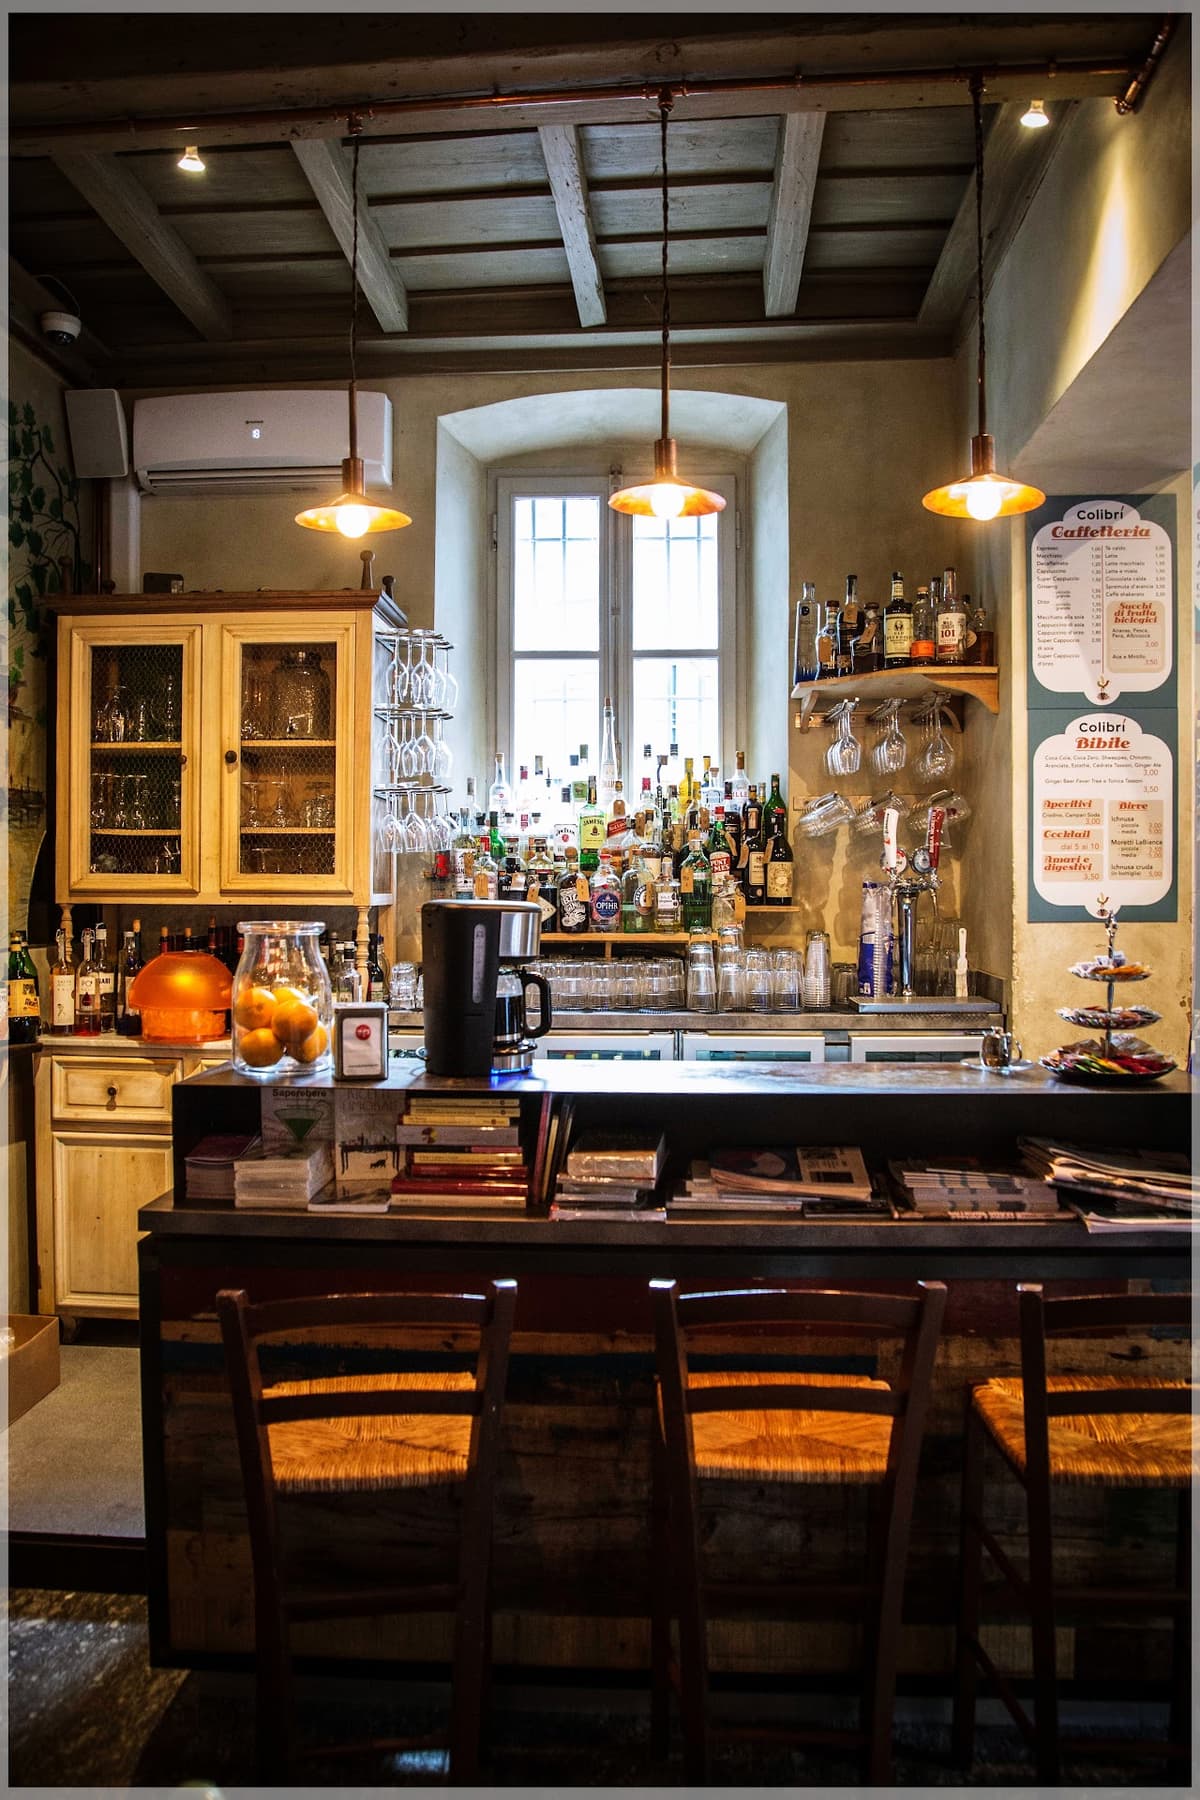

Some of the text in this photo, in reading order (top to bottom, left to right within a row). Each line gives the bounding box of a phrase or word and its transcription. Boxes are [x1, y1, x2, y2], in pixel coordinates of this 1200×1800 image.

[1077, 506, 1125, 520] Colibrí
[1051, 525, 1151, 538] Caffetteria
[1119, 602, 1153, 610] Succhi
[1114, 609, 1157, 617] di frutta
[1114, 616, 1158, 625] biologici
[940, 629, 955, 638] 101
[1079, 718, 1126, 733] Colibrí
[1075, 736, 1131, 749] Bibite
[1043, 799, 1092, 809] Aperitivi
[1119, 801, 1149, 810] Birre
[1043, 829, 1091, 839] Cocktail
[1044, 855, 1081, 863] Amari
[1043, 863, 1093, 872] digestivi
[272, 1087, 327, 1098] Saperebere
